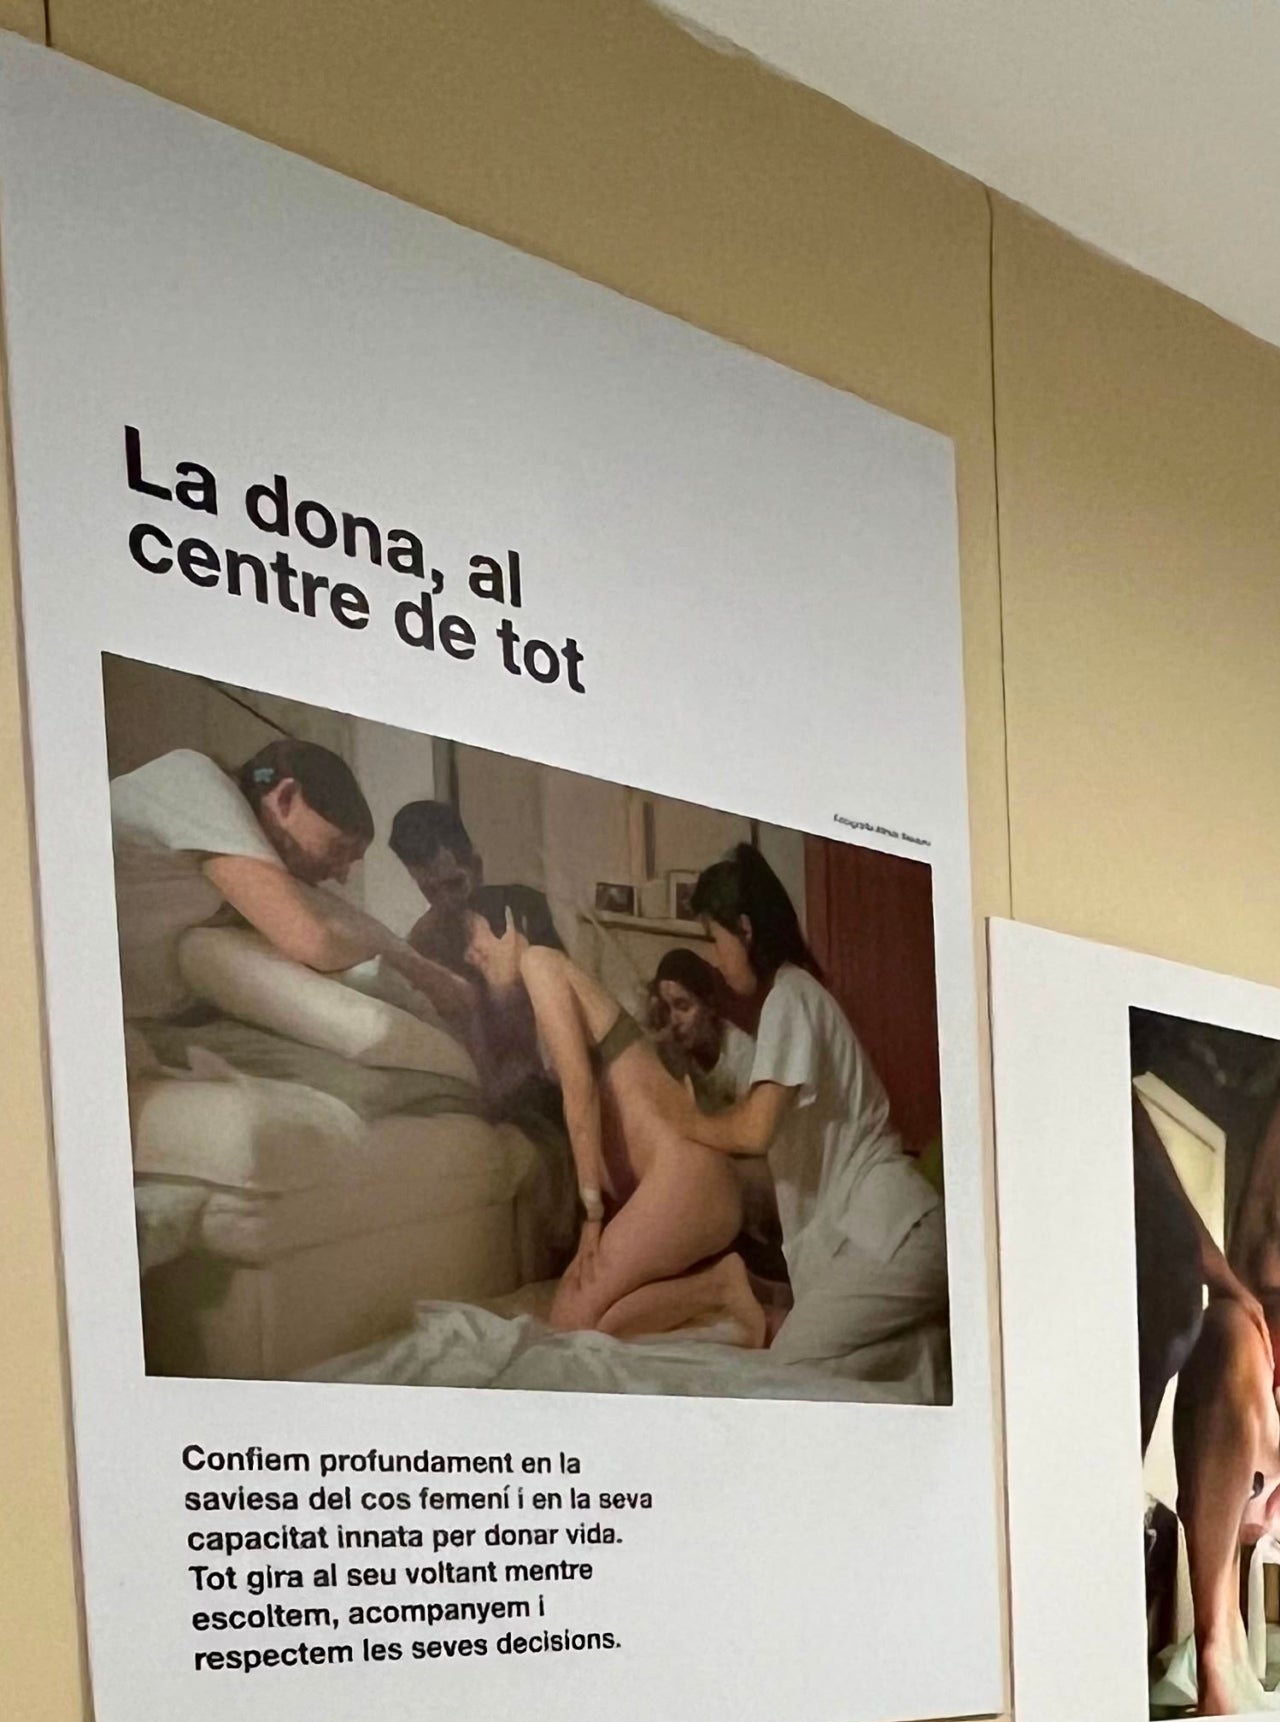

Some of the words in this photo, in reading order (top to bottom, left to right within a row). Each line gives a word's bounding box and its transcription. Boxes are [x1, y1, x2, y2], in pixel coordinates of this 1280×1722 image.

[124, 424, 218, 516] La
[245, 474, 444, 595] dona,
[468, 550, 522, 608] al
[128, 524, 370, 630] centre
[394, 592, 476, 660] de
[496, 618, 586, 694] tot
[182, 1444, 310, 1472] Confiem
[320, 1449, 514, 1478] profundament
[522, 1457, 551, 1474] en
[560, 1452, 580, 1474] la
[185, 1485, 298, 1511] saviesa
[309, 1486, 351, 1510] del
[361, 1492, 411, 1510] cos
[418, 1484, 510, 1510] femení
[518, 1487, 524, 1509] i
[532, 1492, 562, 1510] en
[570, 1487, 590, 1510] la
[599, 1493, 652, 1509] seva
[188, 1524, 329, 1556] capacitat
[337, 1524, 423, 1548] innata
[433, 1529, 476, 1553] per
[485, 1523, 559, 1546] donar
[566, 1522, 623, 1544] vida.
[188, 1566, 238, 1590] Tot
[247, 1564, 304, 1596] gira
[314, 1563, 337, 1587] al
[347, 1568, 396, 1586] seu
[405, 1560, 498, 1584] voltant
[505, 1560, 592, 1582] mentre
[192, 1604, 339, 1631] escoltem,
[348, 1601, 530, 1626] acompanyem
[539, 1594, 544, 1616] i
[195, 1642, 353, 1674] respectem
[363, 1638, 403, 1662] les
[412, 1638, 488, 1659] seves
[496, 1628, 621, 1654] decisions.
